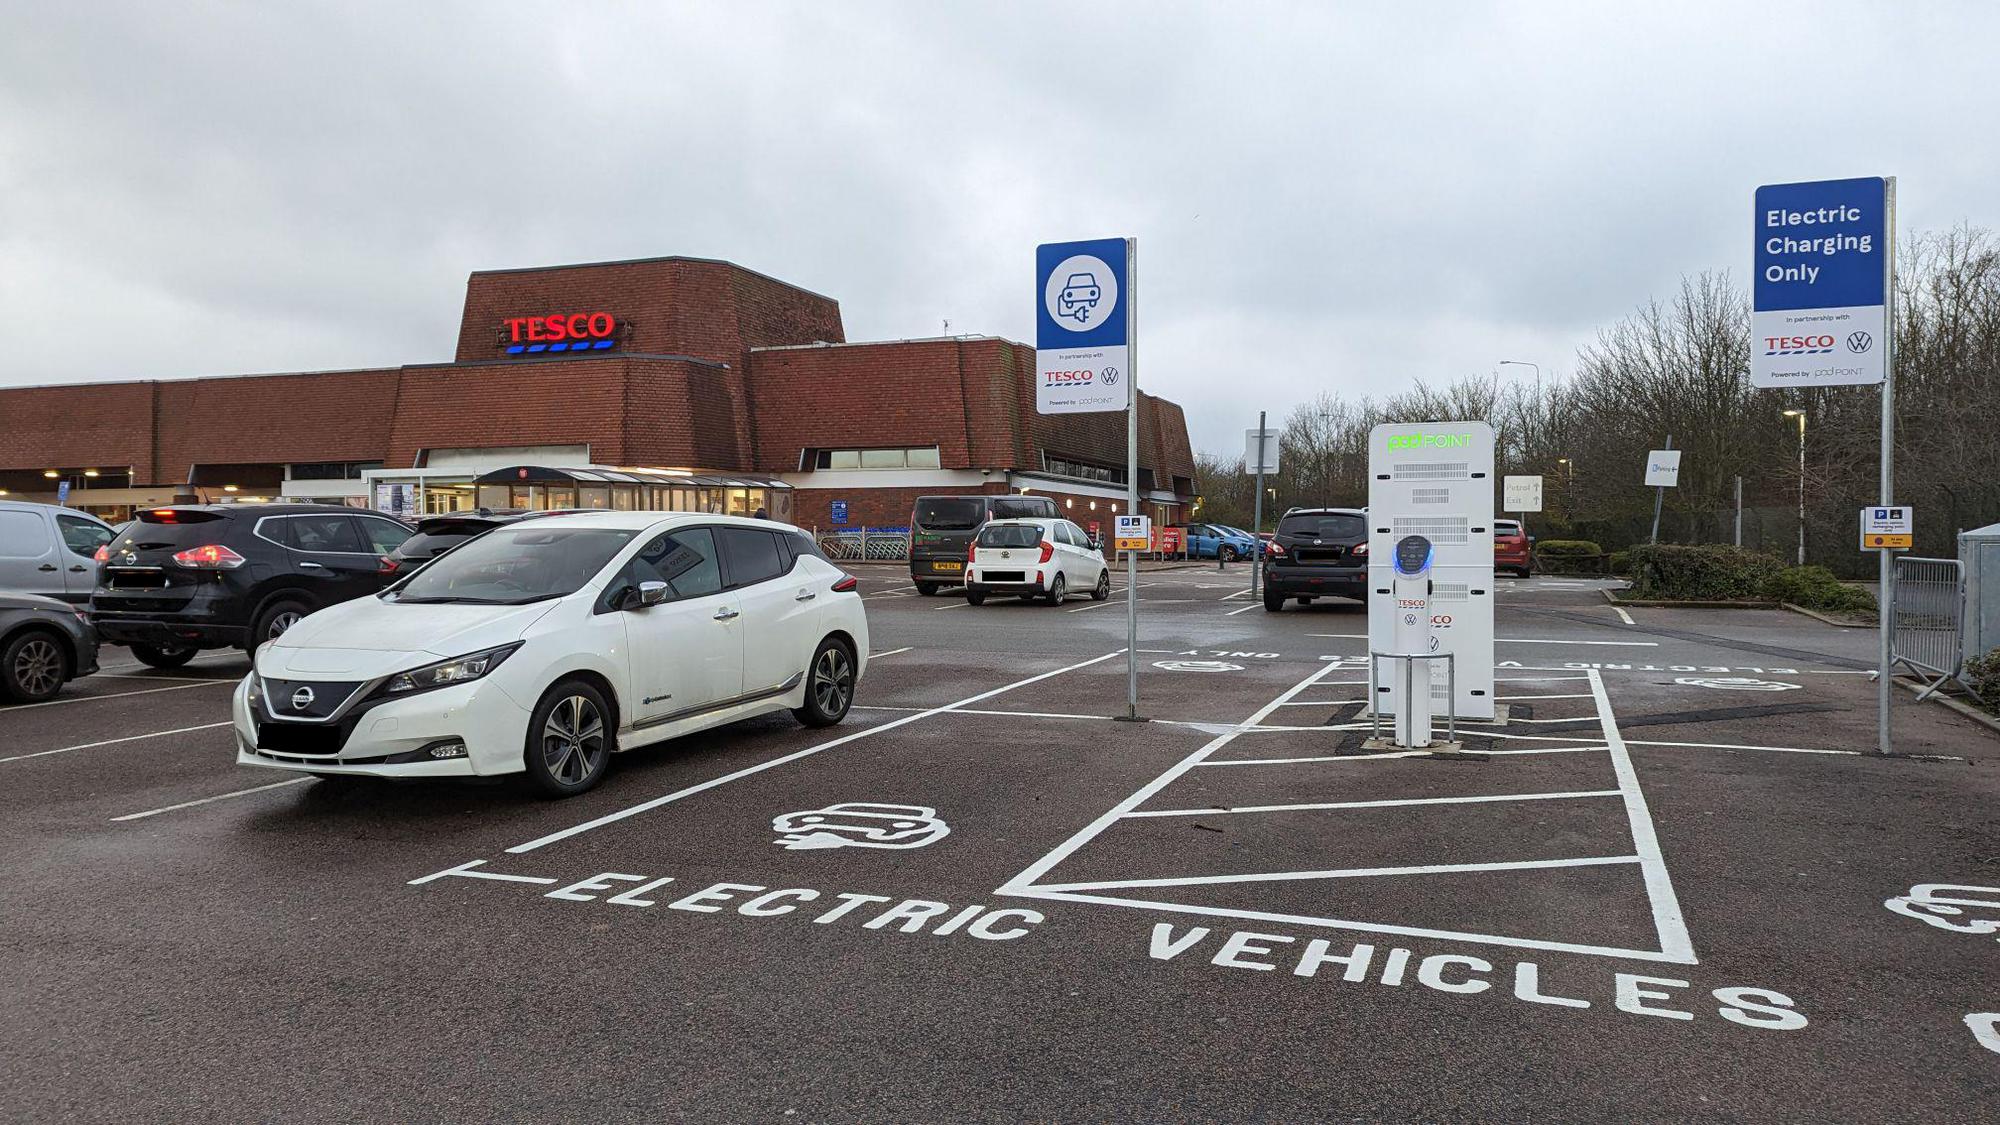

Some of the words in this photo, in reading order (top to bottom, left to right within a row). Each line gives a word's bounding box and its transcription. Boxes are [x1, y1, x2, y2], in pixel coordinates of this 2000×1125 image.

[1767, 205, 1861, 227] Electric
[1766, 233, 1872, 255] Charging
[1765, 263, 1820, 285] Only
[503, 311, 615, 342] TESCO
[1794, 315, 1834, 324] partnership
[1835, 313, 1850, 321] with
[1765, 335, 1835, 350] TESCO
[1044, 369, 1093, 382] TESCO
[1771, 371, 1800, 379] Powered
[1800, 370, 1810, 379] by
[1506, 483, 1531, 491] Petrol
[1506, 496, 1522, 504] Exit
[544, 871, 1046, 941] ELECTRIC
[1148, 922, 1808, 1031] VEHICLES
